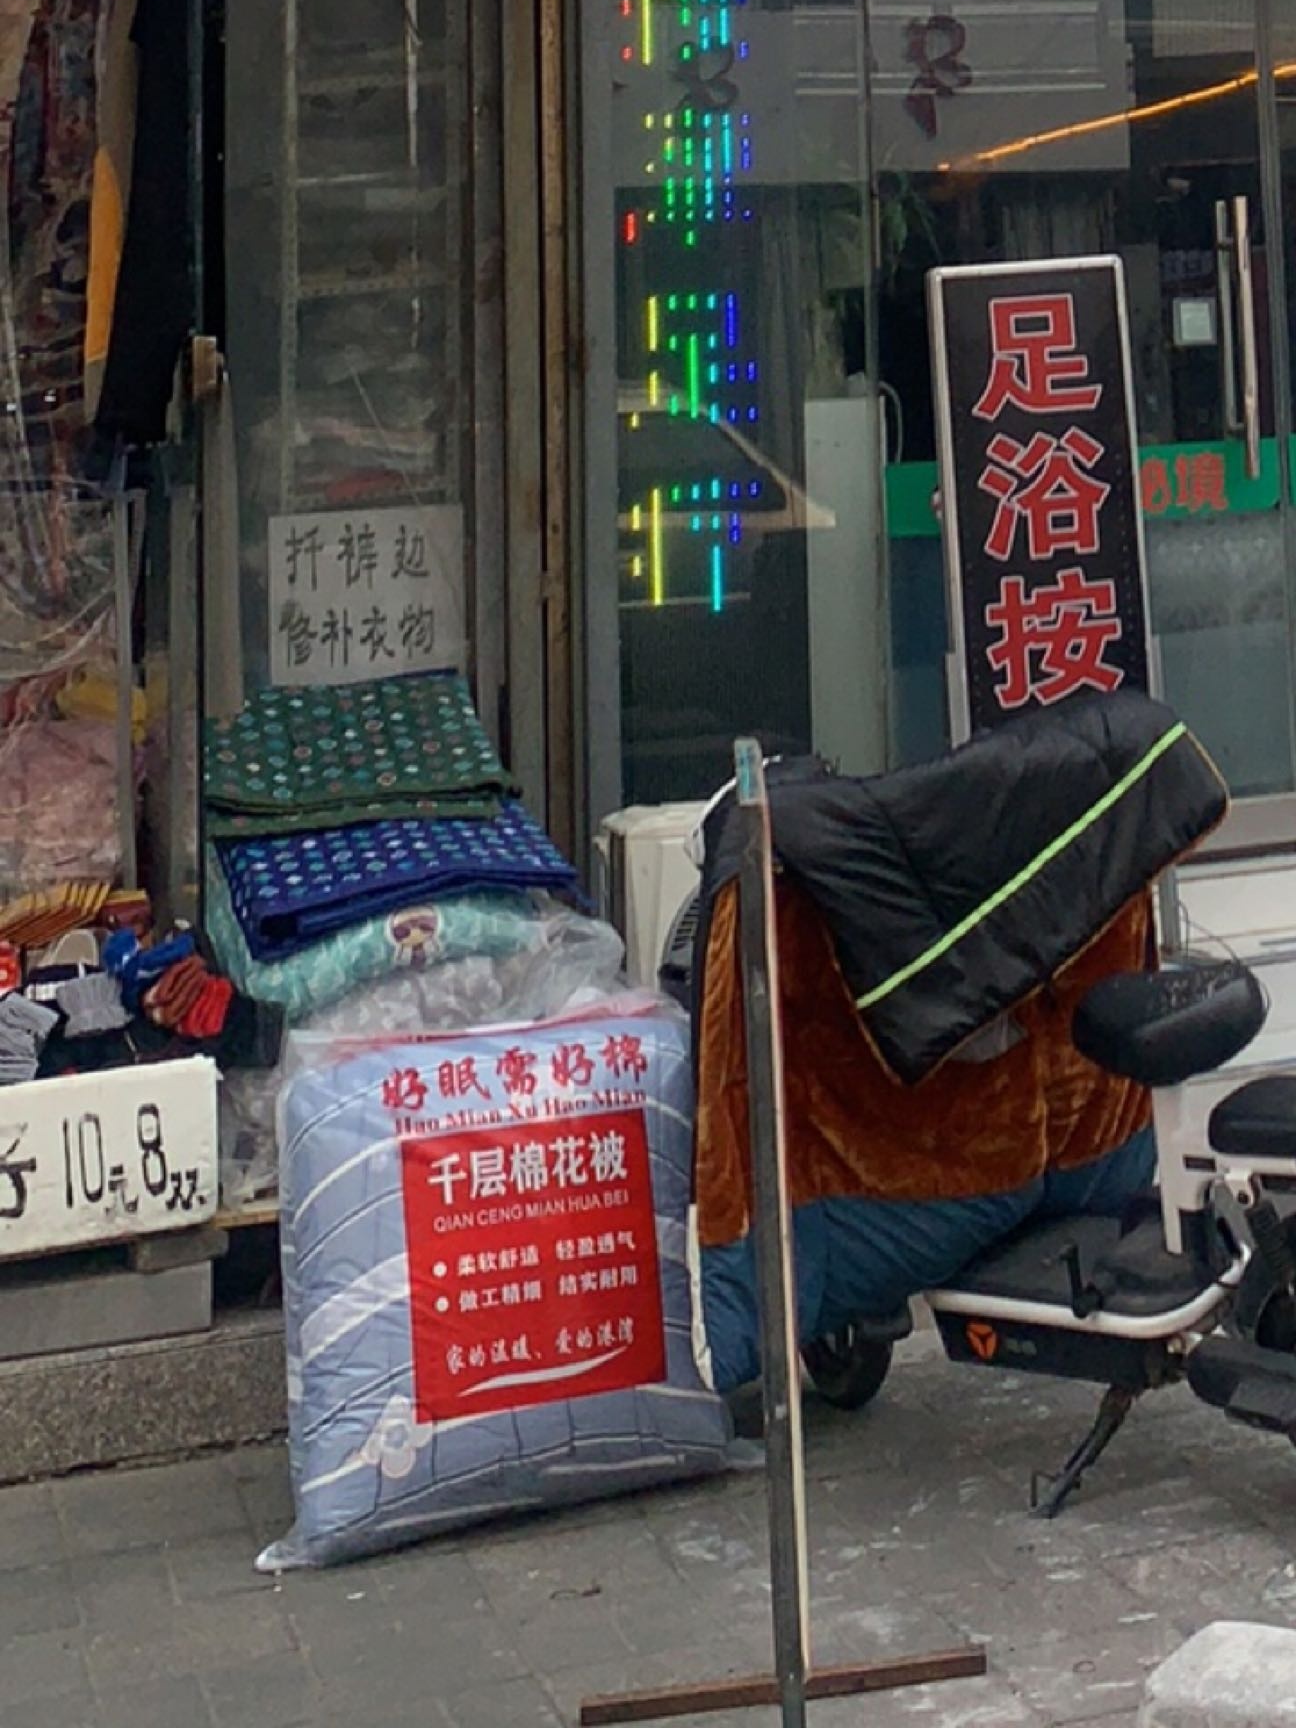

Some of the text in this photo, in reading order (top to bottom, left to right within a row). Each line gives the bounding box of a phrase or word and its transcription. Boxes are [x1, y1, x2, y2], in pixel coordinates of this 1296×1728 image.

[973, 291, 1126, 709] 足浴按
[381, 1032, 649, 1111] 好眠需好棉
[427, 1129, 628, 1206] 千层棉花被
[433, 1212, 475, 1233] QIAN
[526, 1197, 566, 1218] MIAN
[568, 1192, 602, 1212] HUA
[604, 1187, 630, 1208] BEI
